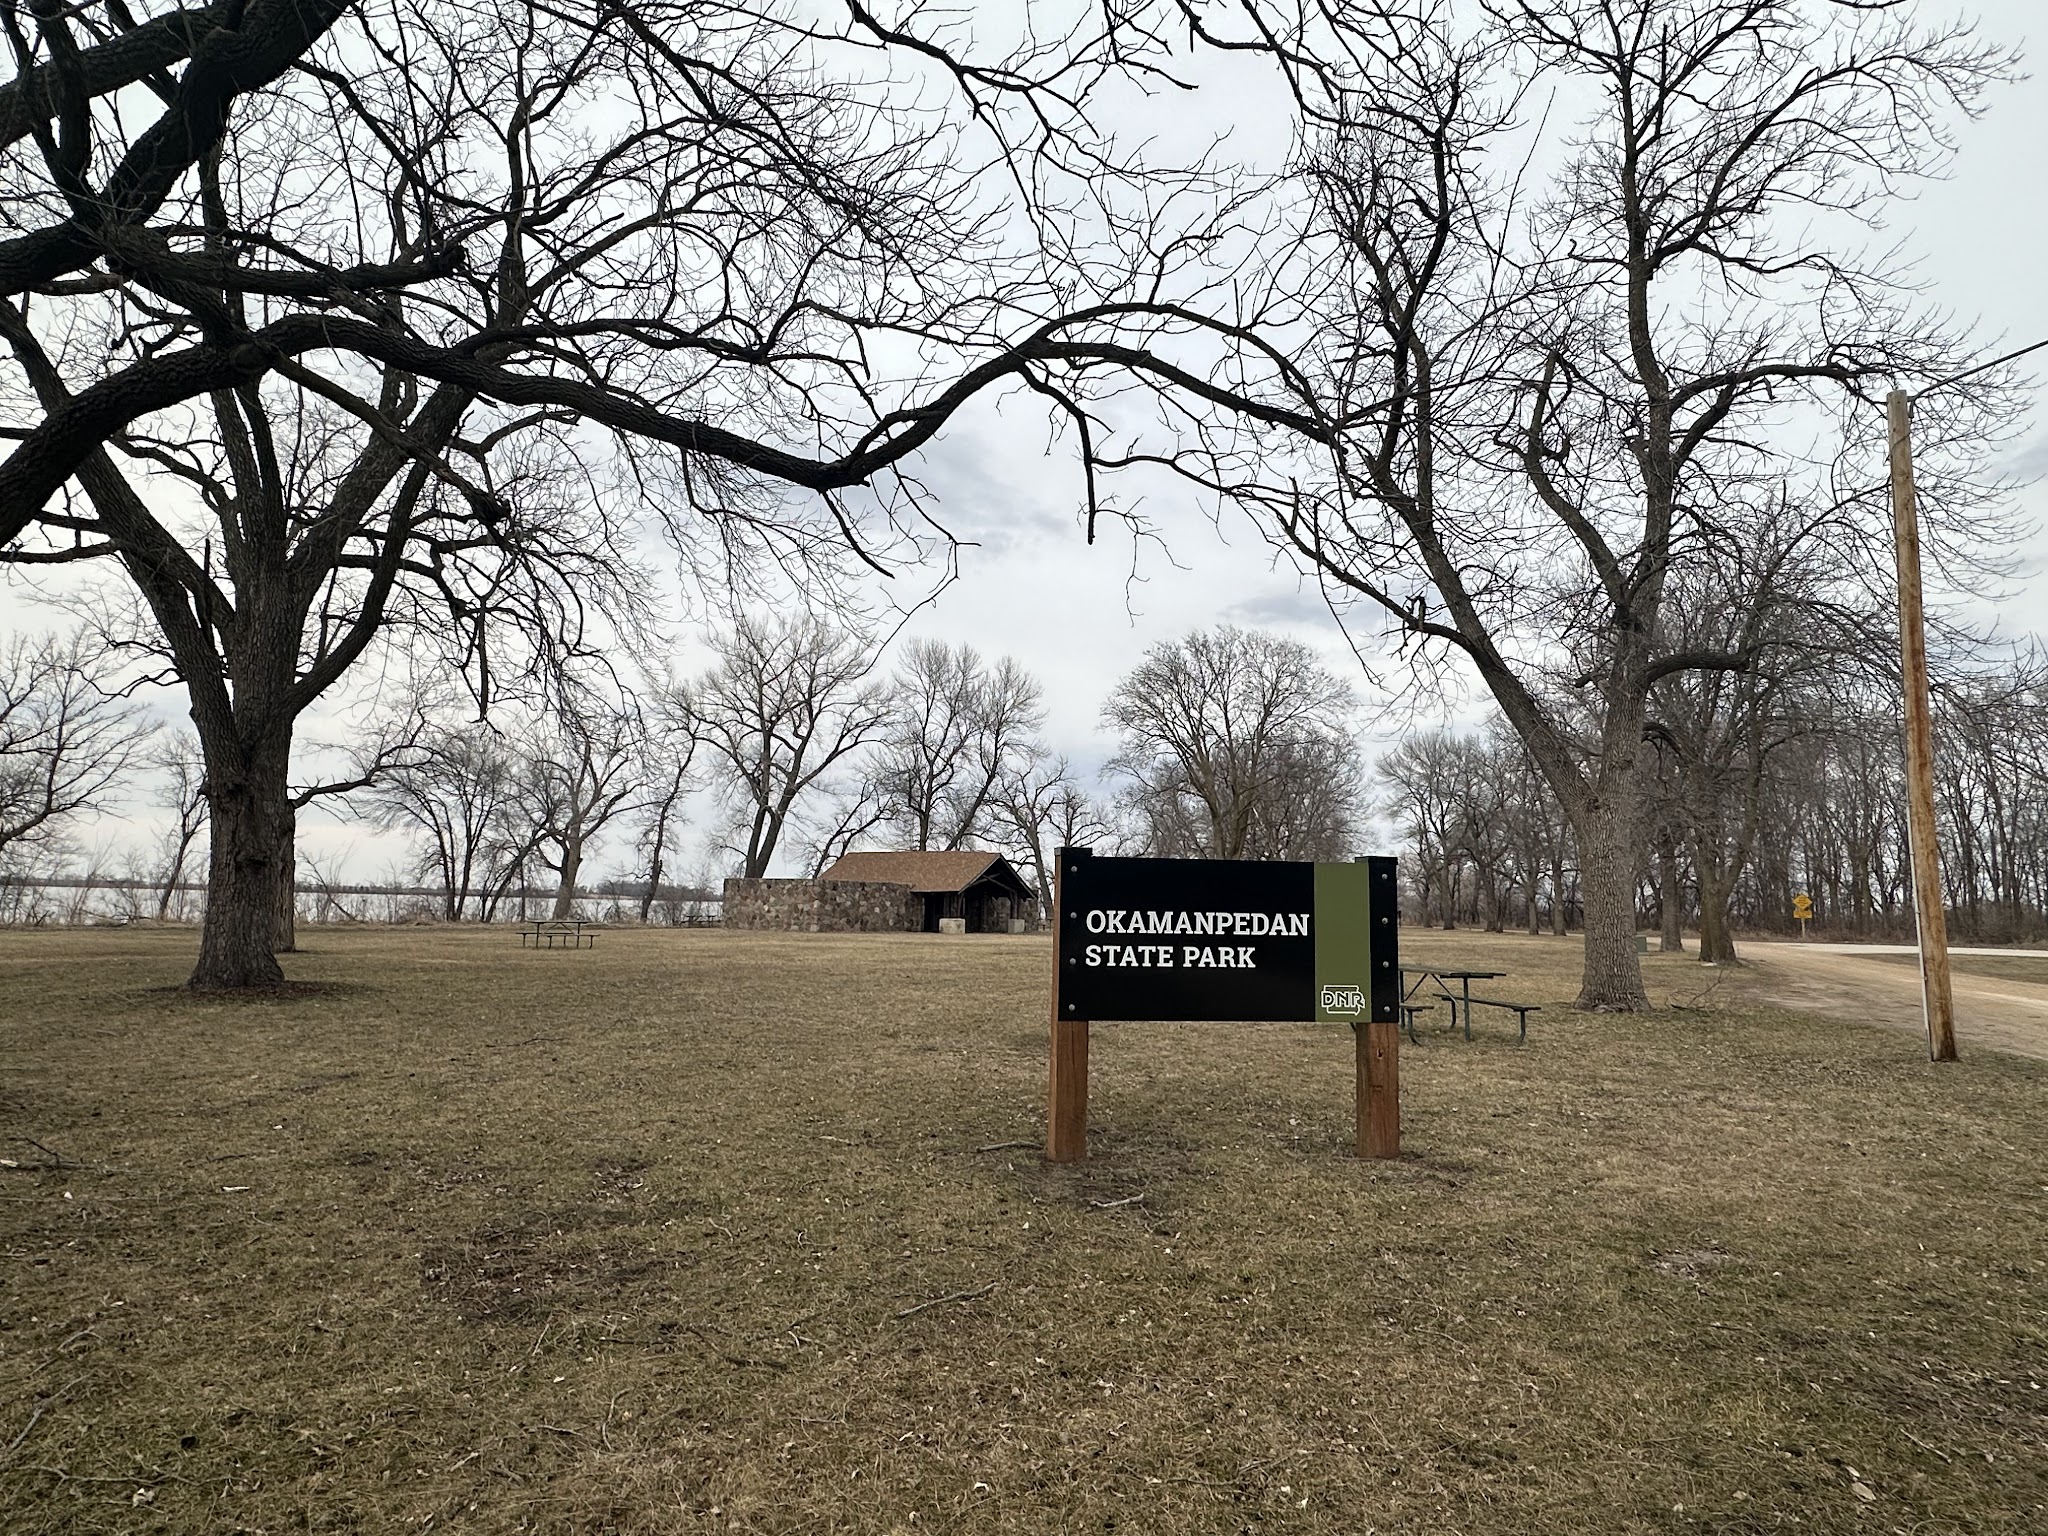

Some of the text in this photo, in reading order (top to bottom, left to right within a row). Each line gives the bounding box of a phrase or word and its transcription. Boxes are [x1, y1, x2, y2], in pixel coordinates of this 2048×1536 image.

[1085, 909, 1310, 936] OKAMANPEDAN
[1085, 945, 1256, 968] STATE PARK
[1321, 990, 1366, 1008] DNR
